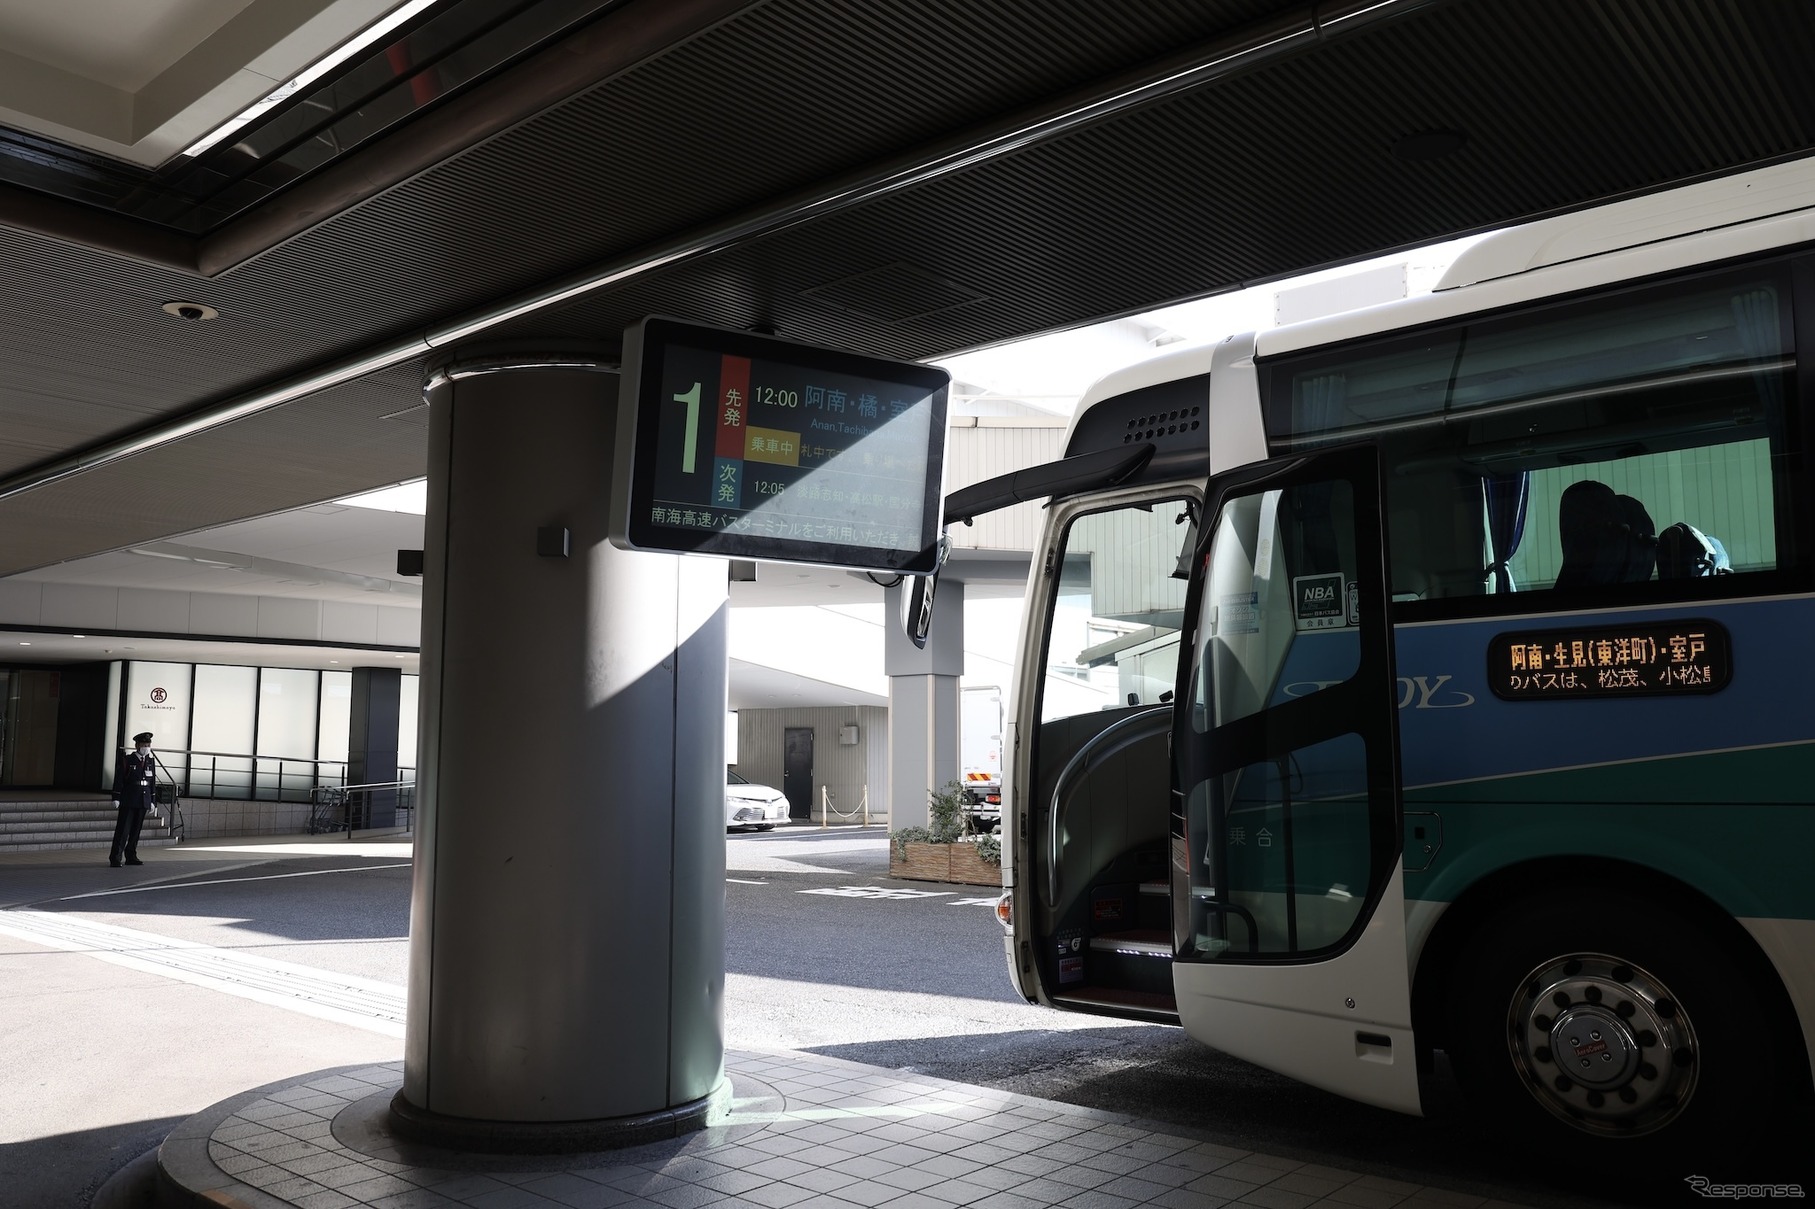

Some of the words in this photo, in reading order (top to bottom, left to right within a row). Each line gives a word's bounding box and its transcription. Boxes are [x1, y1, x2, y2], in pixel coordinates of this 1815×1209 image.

[724, 388, 742, 427] 先発
[755, 385, 798, 408] 12:00
[673, 382, 701, 474] 1
[751, 436, 793, 456] 乗車中
[718, 463, 737, 503] 次発
[754, 480, 785, 496] 12:05
[1303, 586, 1335, 601] NBA
[1229, 826, 1273, 848] 乗合
